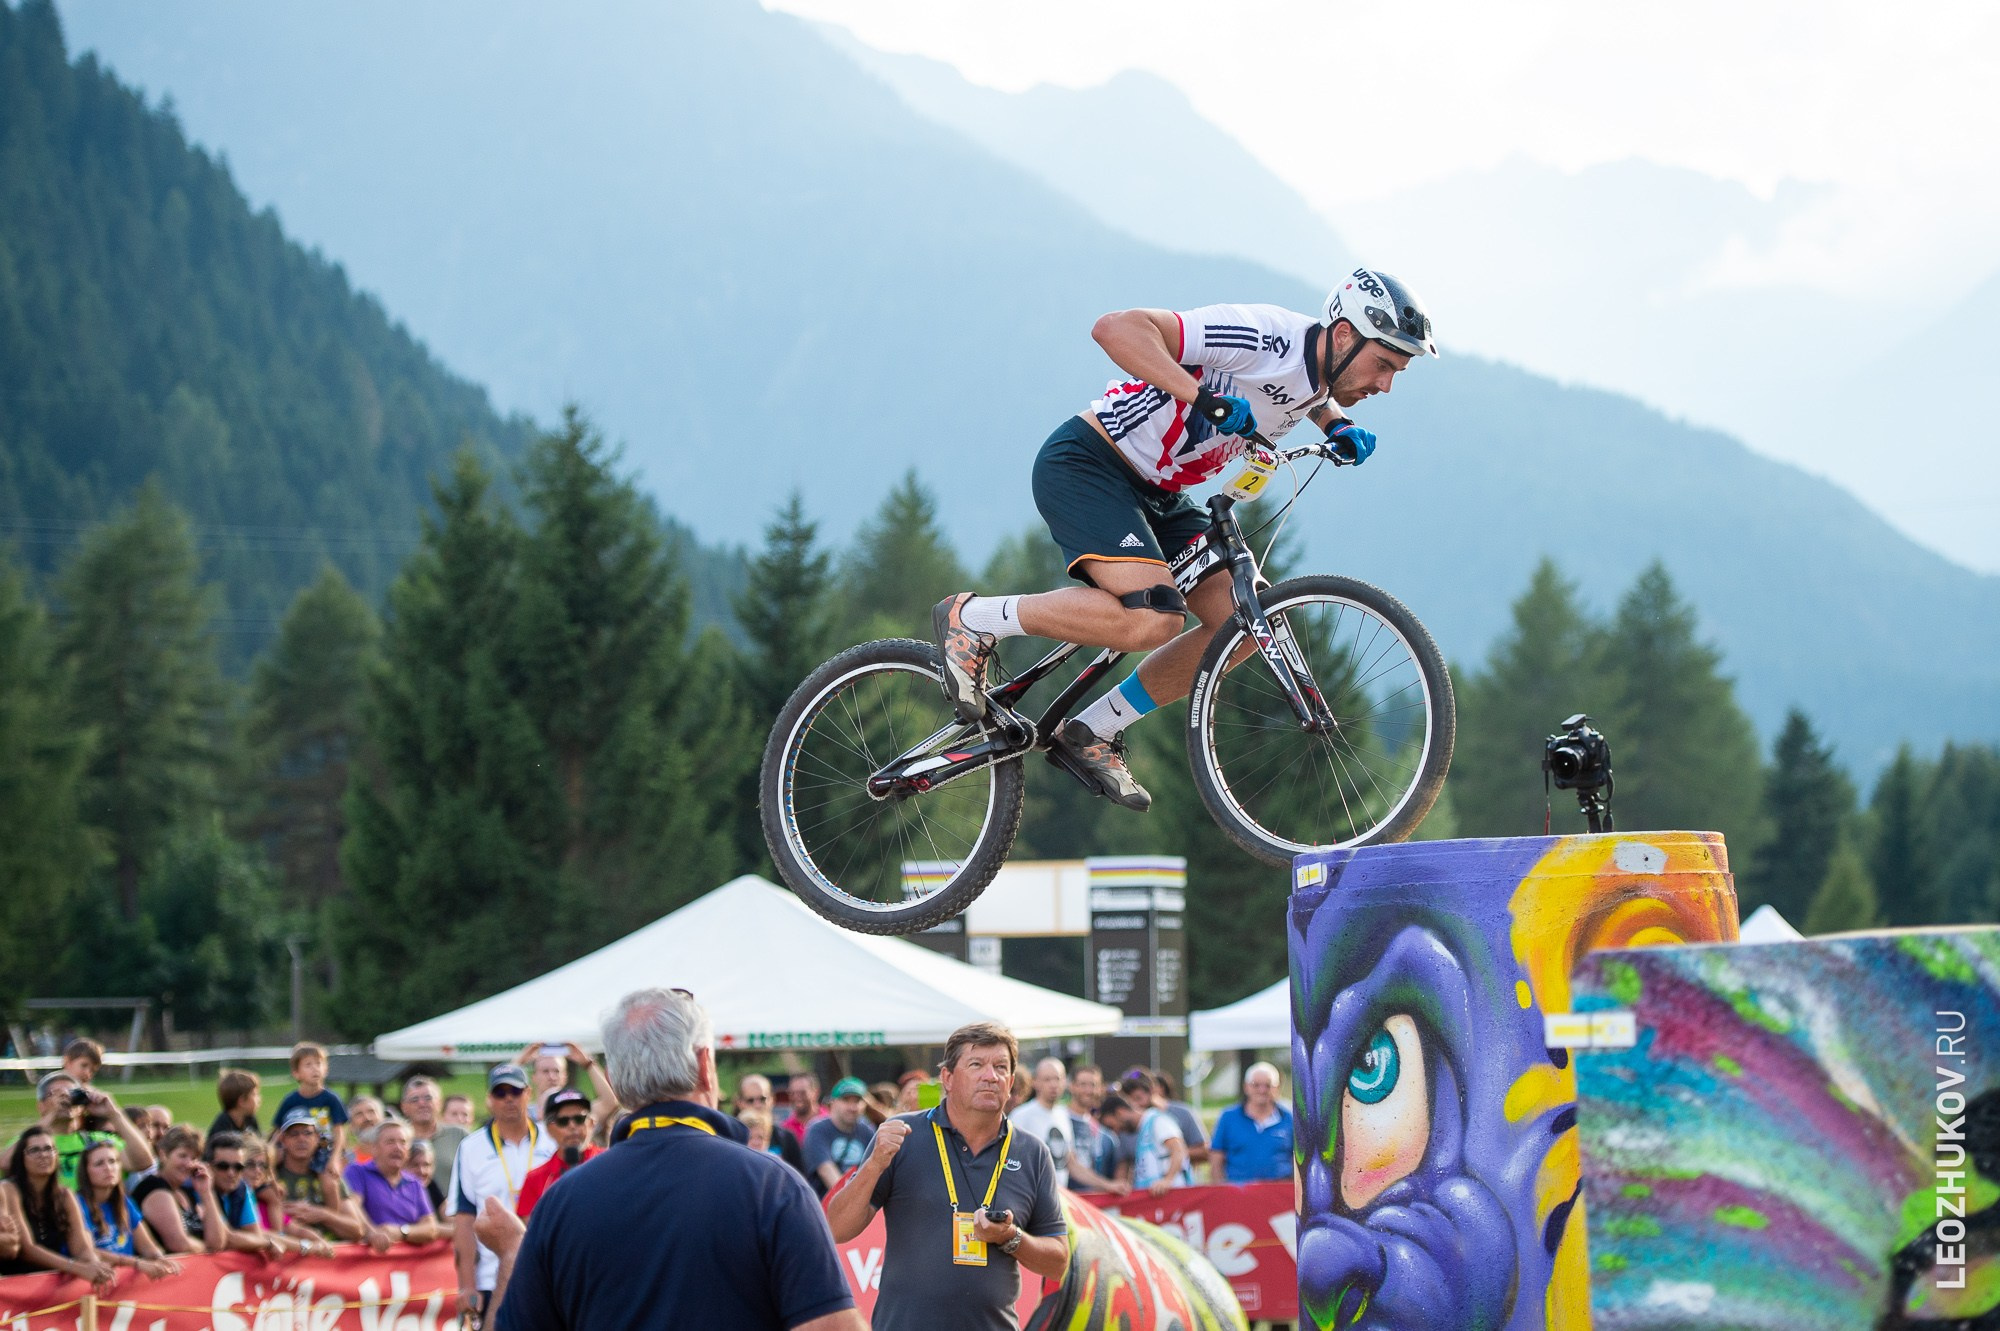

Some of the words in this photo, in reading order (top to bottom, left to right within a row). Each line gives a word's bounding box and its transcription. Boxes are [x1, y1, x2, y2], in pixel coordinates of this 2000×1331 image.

[1352, 267, 1385, 299] urge
[1261, 334, 1291, 360] sky
[1256, 383, 1296, 406] sky
[1243, 476, 1260, 491] 2
[1119, 539, 1145, 548] adidas
[748, 1030, 886, 1049] Heineken
